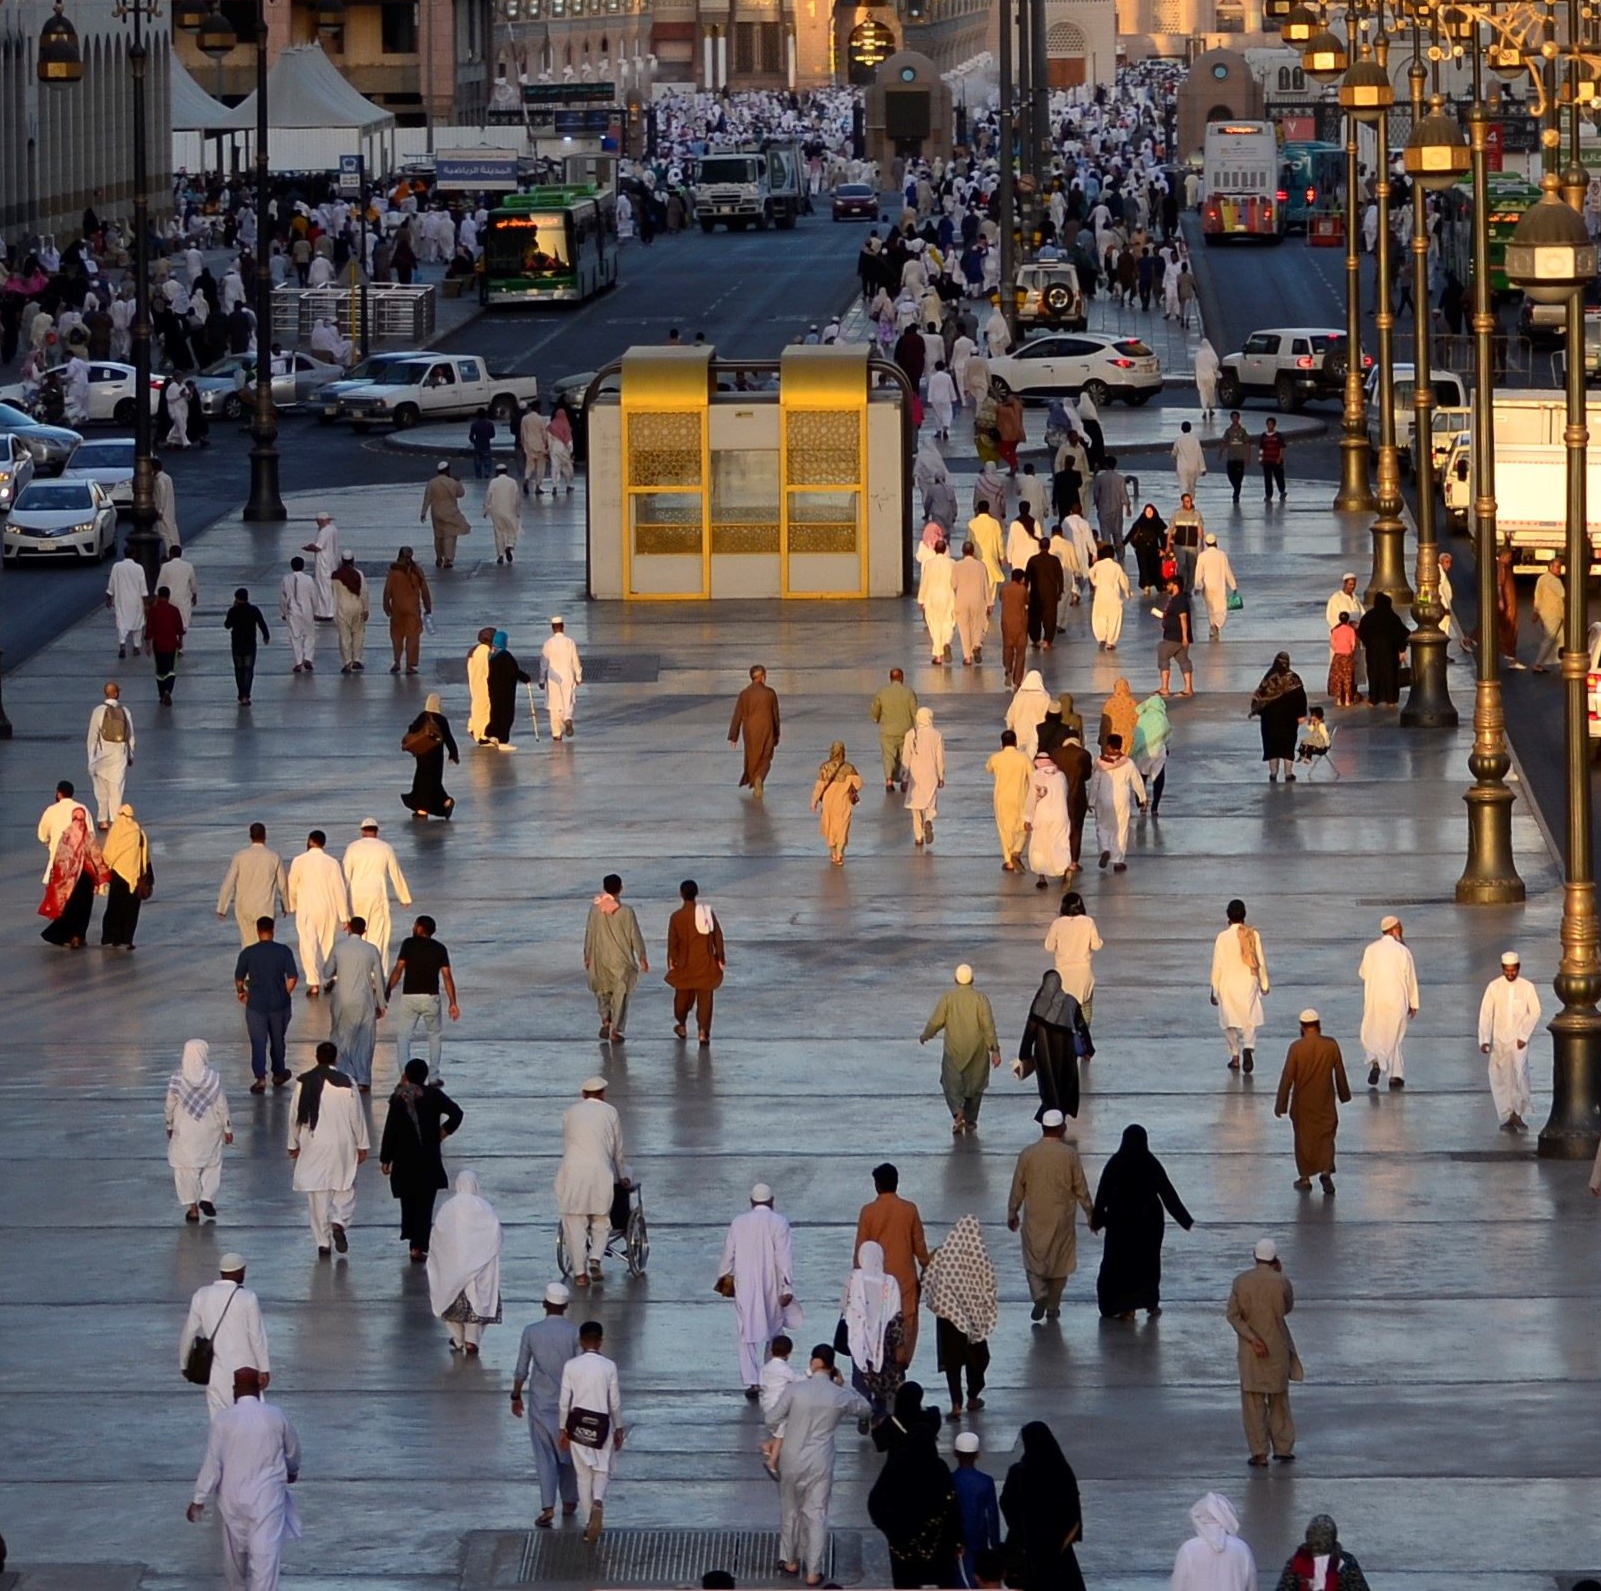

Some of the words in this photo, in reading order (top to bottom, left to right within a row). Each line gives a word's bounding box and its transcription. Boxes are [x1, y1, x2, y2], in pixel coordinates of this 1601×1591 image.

[1487, 131, 1497, 142] 4
[443, 166, 477, 176] الرياضية
[479, 166, 512, 176] المدينة
